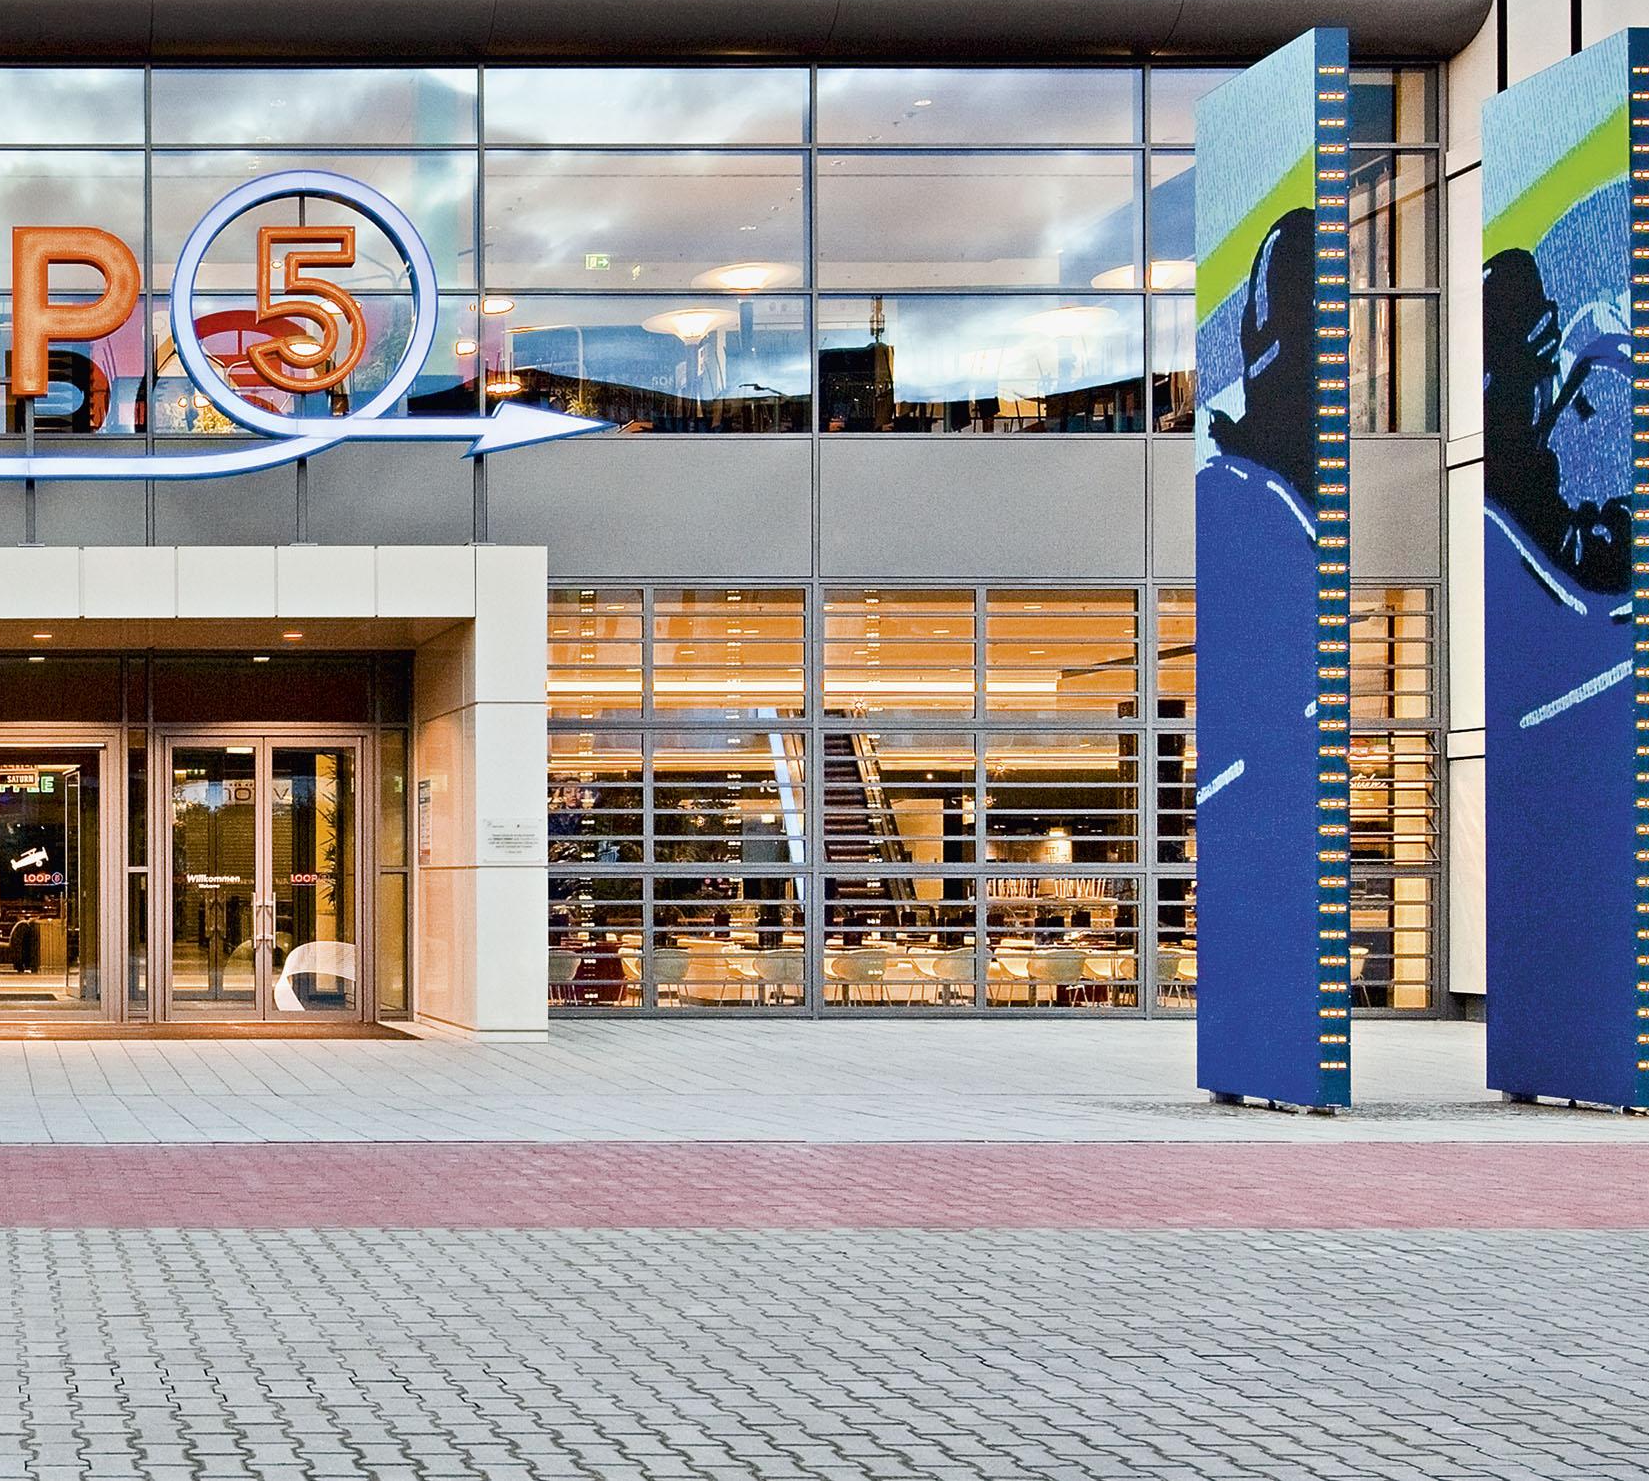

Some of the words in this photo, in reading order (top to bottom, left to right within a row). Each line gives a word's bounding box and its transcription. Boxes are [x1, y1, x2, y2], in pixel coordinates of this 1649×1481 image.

[246, 225, 369, 394] 5
[6, 775, 35, 784] SATURN
[23, 874, 51, 883] LOOP
[186, 873, 241, 883] Willkommen
[290, 874, 317, 883] LOOP
